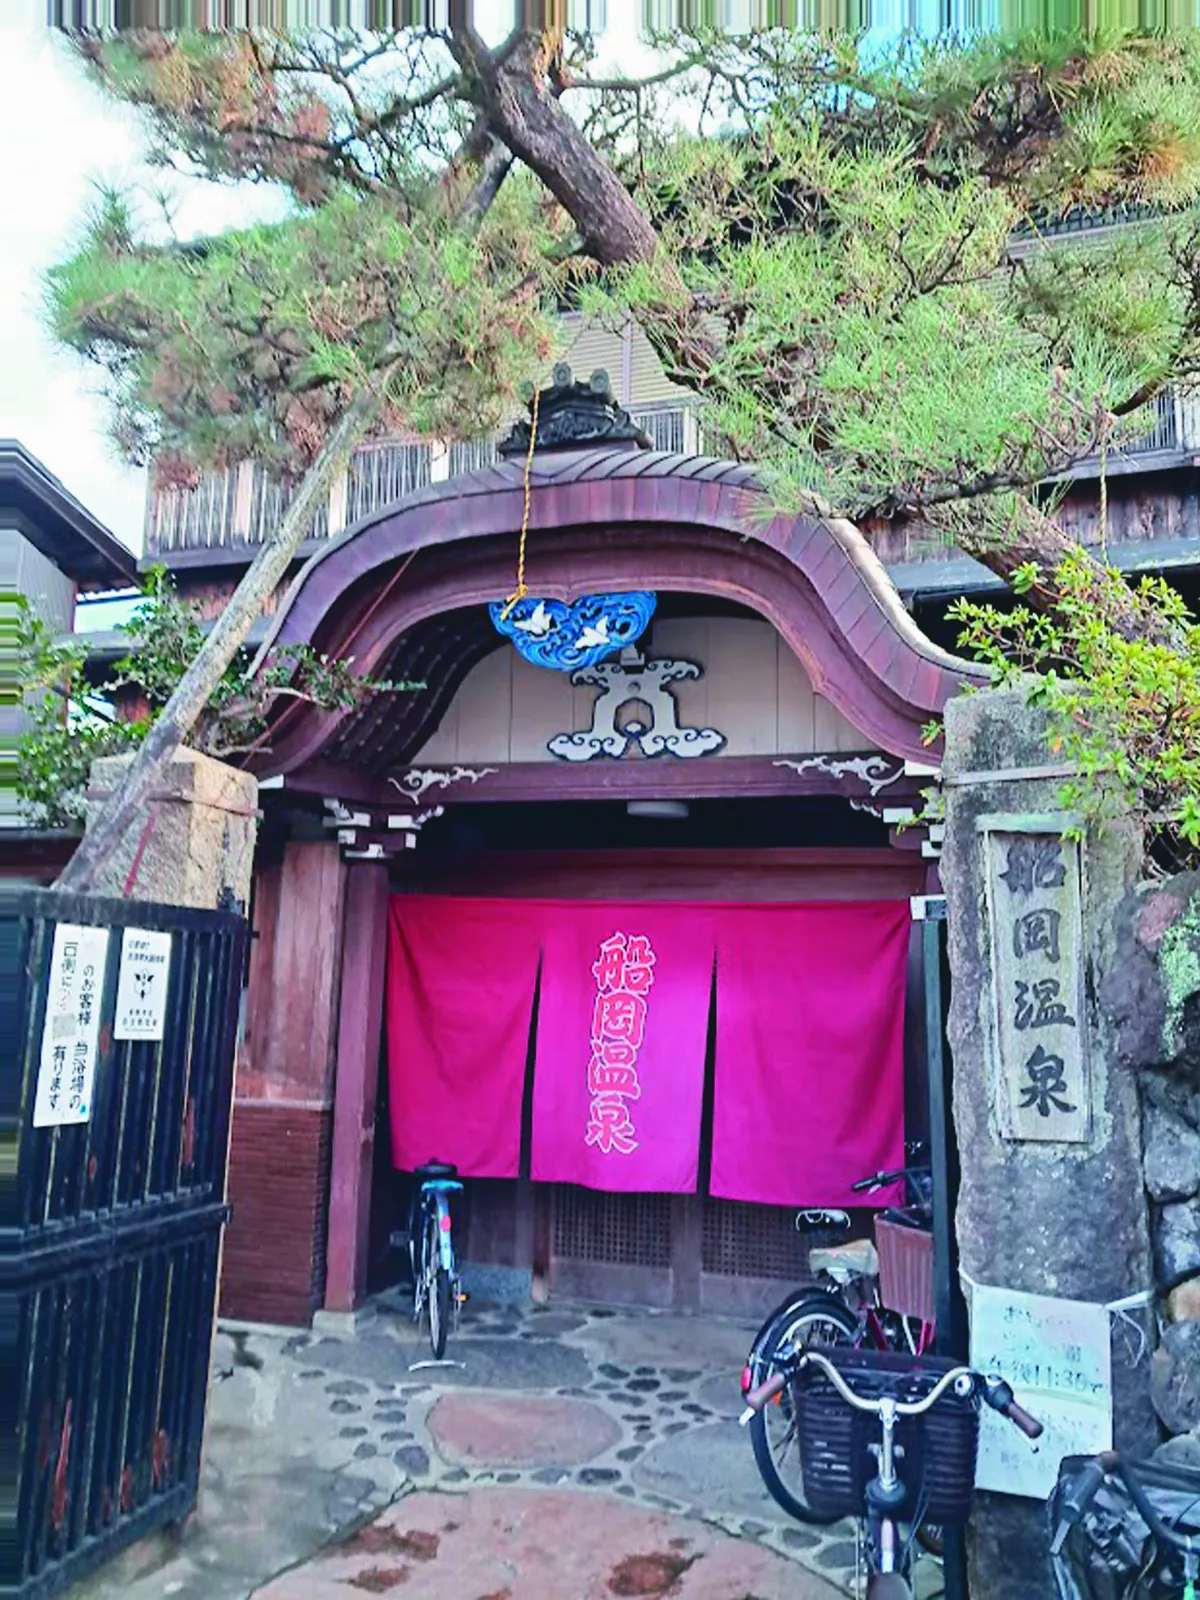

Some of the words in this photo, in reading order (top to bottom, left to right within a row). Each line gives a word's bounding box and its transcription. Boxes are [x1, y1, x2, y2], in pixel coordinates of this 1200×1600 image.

[585, 932, 656, 1155] 船岡温泉
[998, 834, 1077, 1118] 船岡温泉
